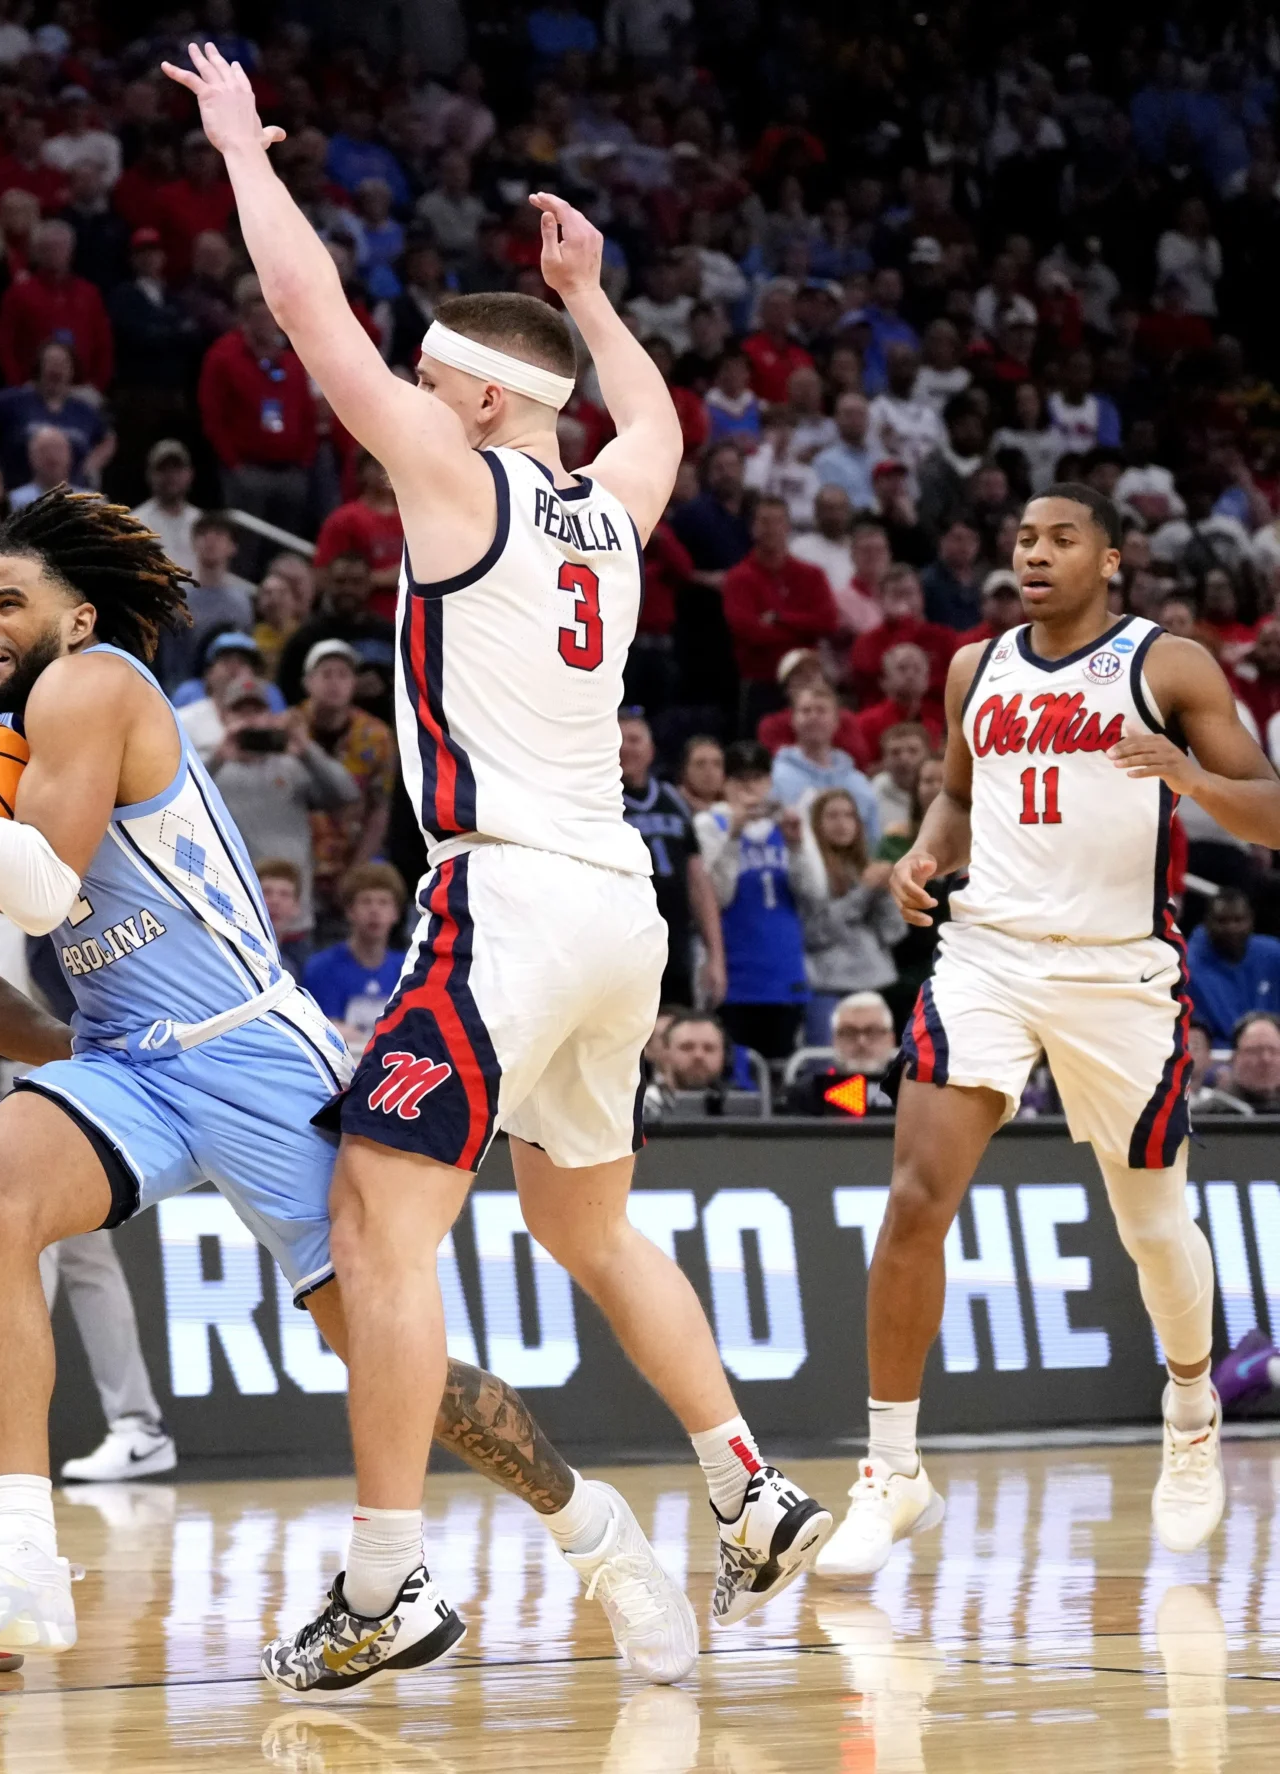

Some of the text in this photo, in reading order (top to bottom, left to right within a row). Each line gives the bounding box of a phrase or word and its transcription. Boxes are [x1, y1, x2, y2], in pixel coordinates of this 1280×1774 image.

[534, 487, 622, 551] PEDULLA
[558, 560, 603, 671] 3
[1091, 652, 1120, 677] SEC
[973, 691, 1125, 758] Ole Miss
[1019, 766, 1062, 824] 11
[761, 870, 777, 909] 1
[61, 907, 167, 977] AROLINA
[157, 1190, 581, 1398] RD
